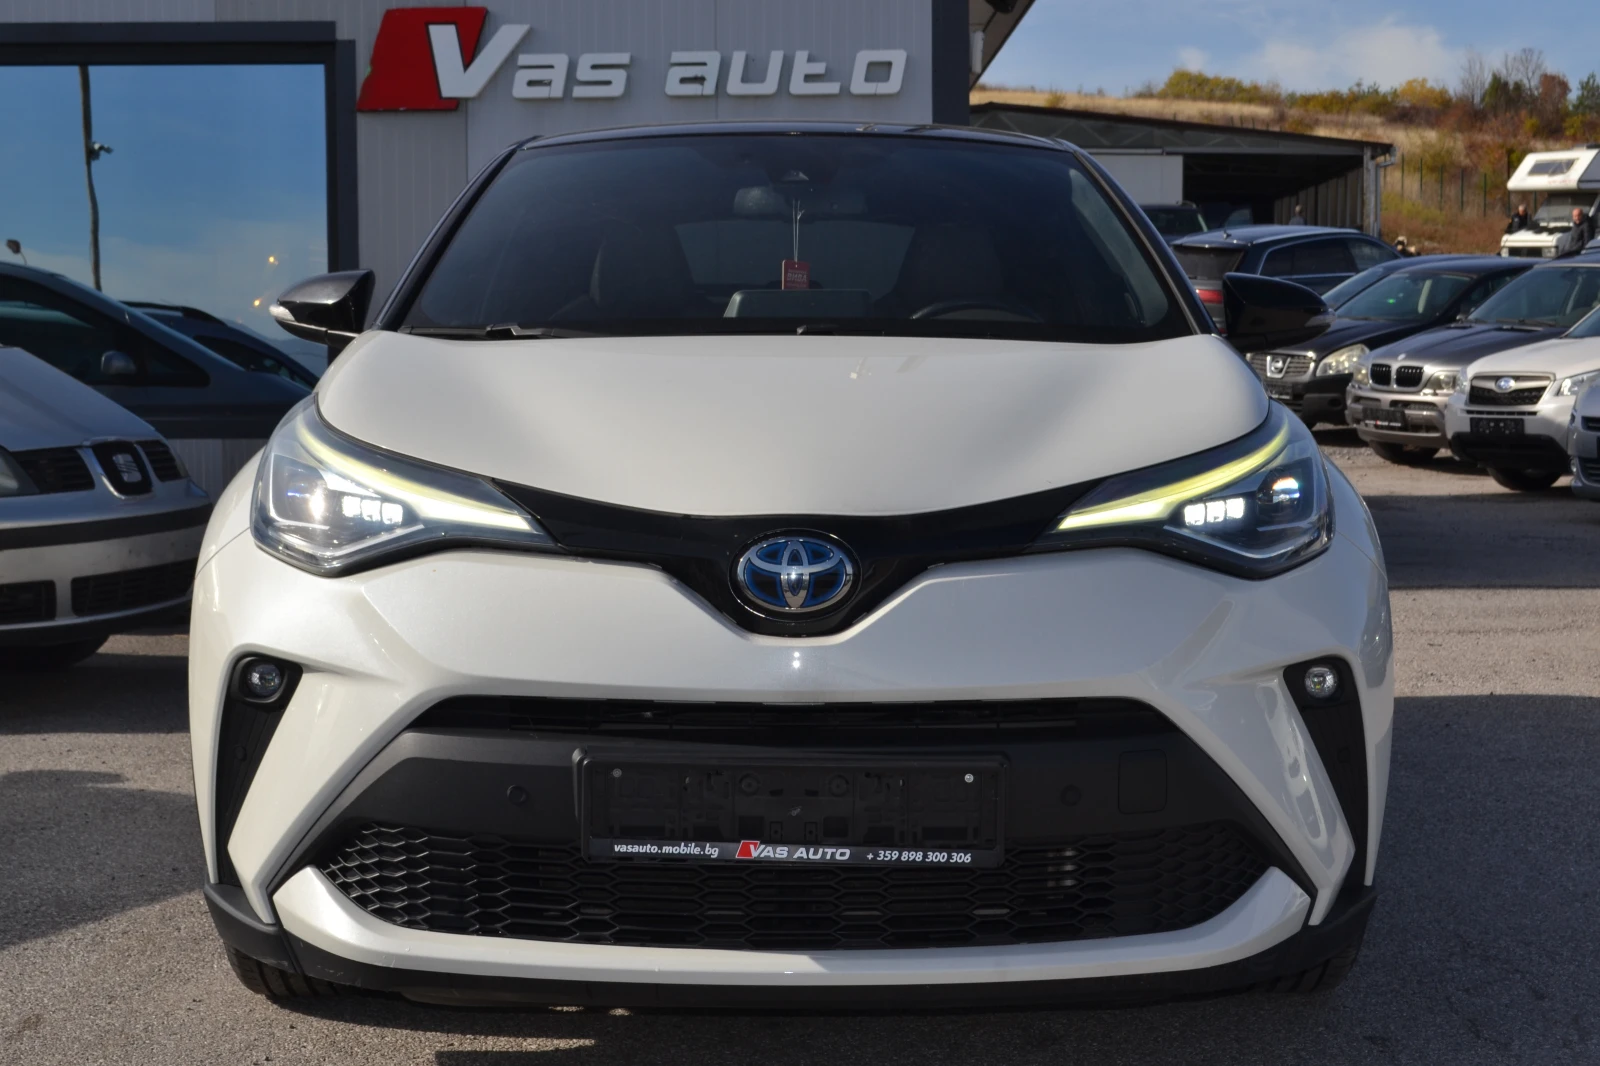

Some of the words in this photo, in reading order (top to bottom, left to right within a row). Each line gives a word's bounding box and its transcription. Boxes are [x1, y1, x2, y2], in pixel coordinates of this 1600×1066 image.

[425, 24, 632, 99] Vas
[664, 48, 908, 97] auto
[613, 841, 720, 858] vasauto.mobile.bg
[750, 844, 789, 859] VAS
[792, 847, 851, 861] AUTO
[876, 850, 900, 861] 359
[900, 851, 924, 862] 898
[925, 852, 948, 863] 300
[949, 852, 972, 863] 306
